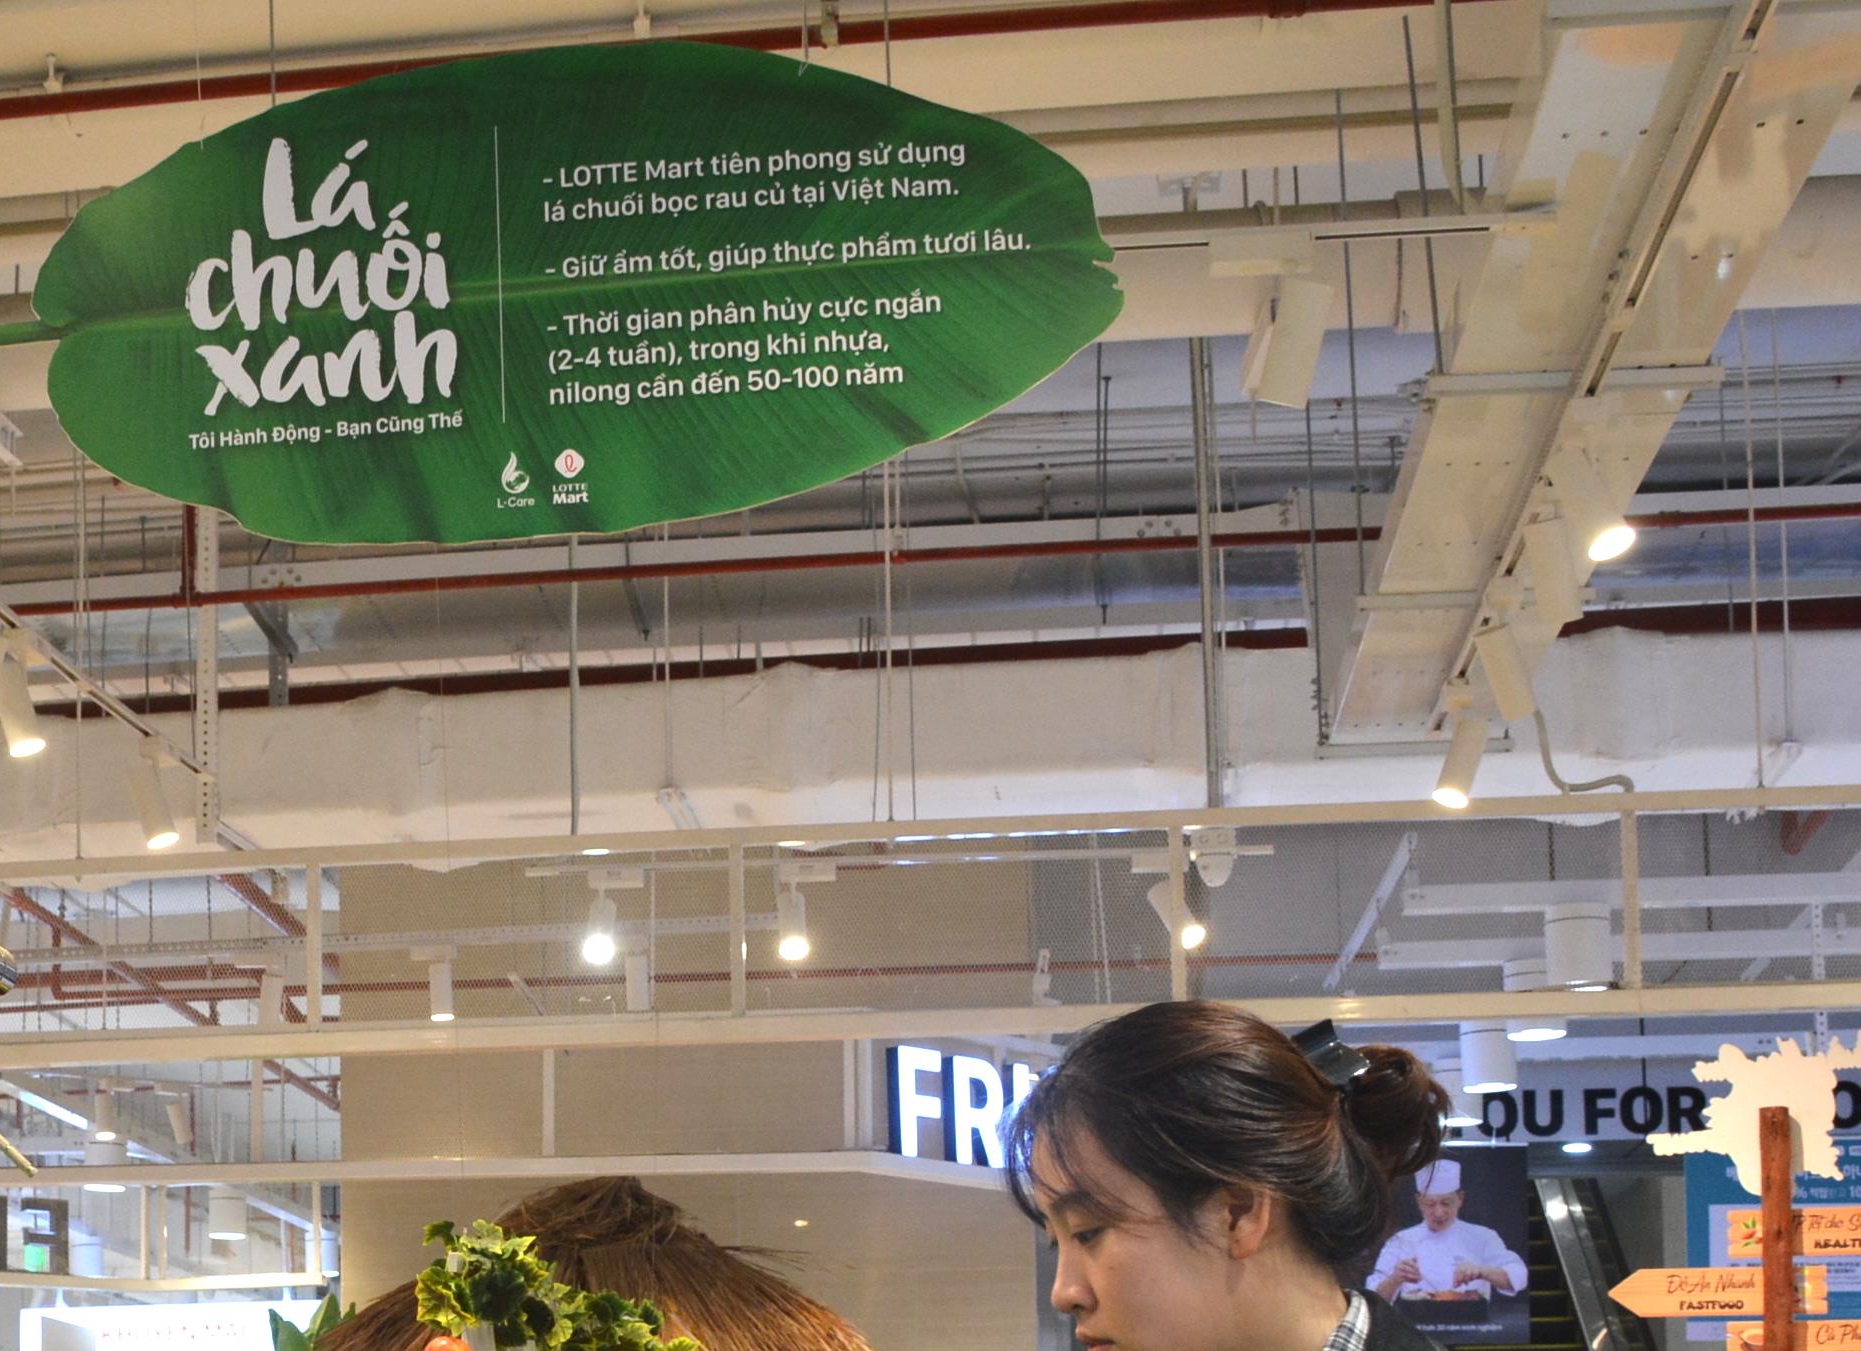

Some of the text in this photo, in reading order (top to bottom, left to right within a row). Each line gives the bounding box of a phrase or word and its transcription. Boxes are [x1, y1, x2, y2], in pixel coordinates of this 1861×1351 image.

[560, 163, 637, 188] LOTTE
[645, 158, 705, 182] Mart
[710, 152, 761, 176] tiên
[768, 149, 851, 177] phong
[858, 142, 892, 167] sử
[898, 142, 966, 168] dụng
[263, 137, 376, 240] Lá
[543, 177, 960, 223] lá chuối bọc rau củ tại Việt Nam.
[185, 201, 451, 331] chuối
[562, 255, 609, 279] Giữ
[613, 250, 653, 275] ẩm
[659, 246, 702, 273] tốt,
[708, 243, 767, 273] giúp
[773, 241, 835, 267] thực
[841, 231, 917, 264] phẩm
[923, 231, 977, 255] tươi
[984, 228, 1032, 252] lâu.
[563, 310, 619, 336] Thời
[626, 308, 683, 337] gian
[690, 301, 756, 331] phân
[762, 297, 813, 325] hủy
[819, 297, 868, 323] cực
[876, 288, 942, 320] ngắn
[195, 310, 459, 416] xanh
[549, 330, 889, 375] (2-4 tuần), trong khi nhựa,
[549, 362, 904, 406] nilong cần đến 50-100 năm
[189, 433, 216, 450] Tôi
[219, 428, 268, 448] Hành
[271, 424, 322, 447] Động
[336, 420, 373, 441] Bạn
[375, 415, 426, 438] Cũng
[428, 409, 464, 431] Thế
[552, 484, 589, 493] LOTTE
[552, 491, 589, 505] Mart
[1584, 1085, 1710, 1137] FOR
[1679, 1299, 1745, 1312] FASTFOOD
[1838, 1323, 1861, 1345] Ph
